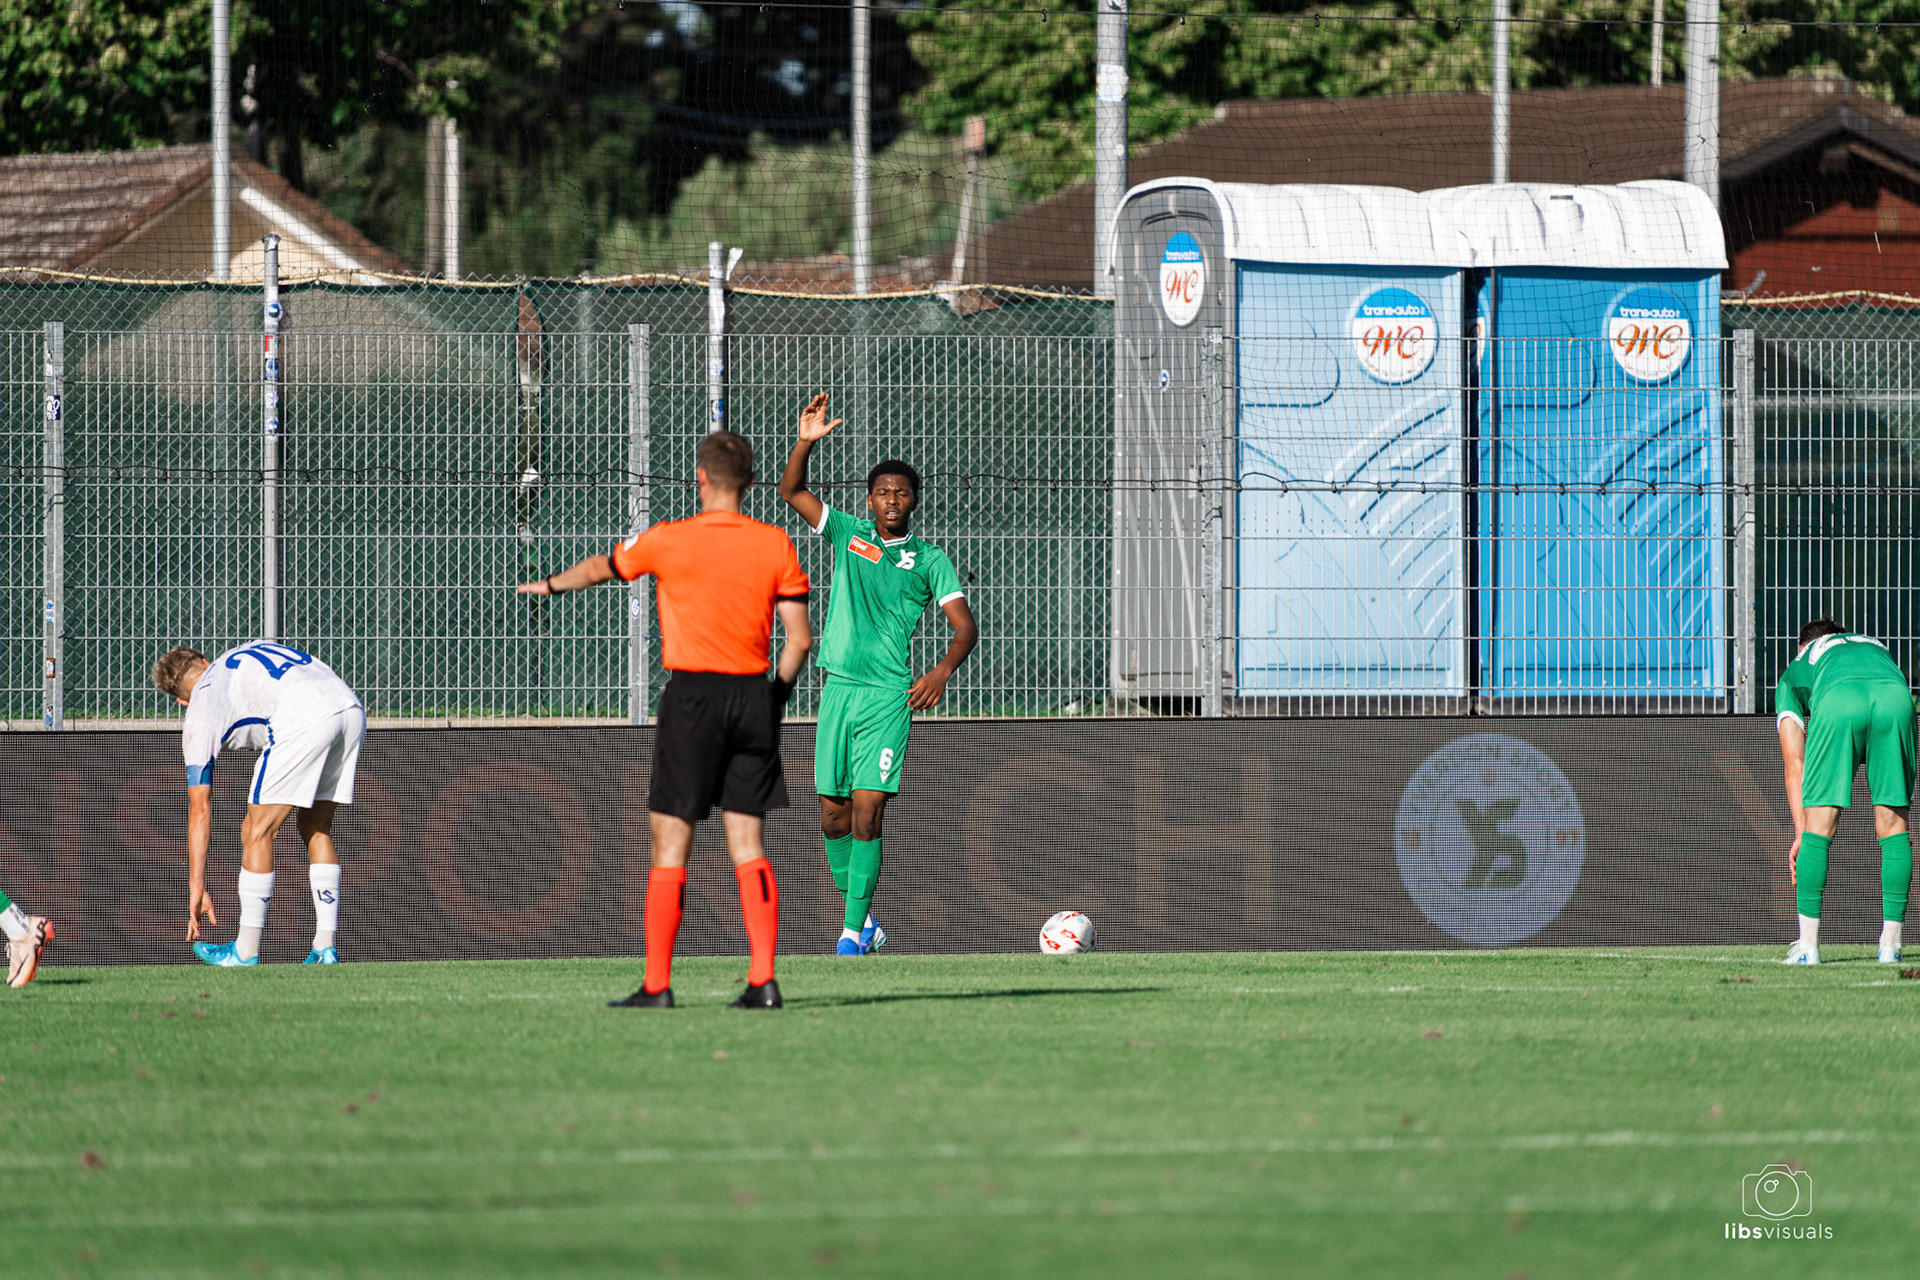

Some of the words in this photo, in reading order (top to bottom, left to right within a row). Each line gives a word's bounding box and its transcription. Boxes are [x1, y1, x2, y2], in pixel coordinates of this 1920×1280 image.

[1165, 270, 1199, 303] WC
[1362, 324, 1424, 359] WC
[1616, 324, 1683, 359] WC
[225, 643, 312, 681] 20
[879, 747, 894, 771] 6
